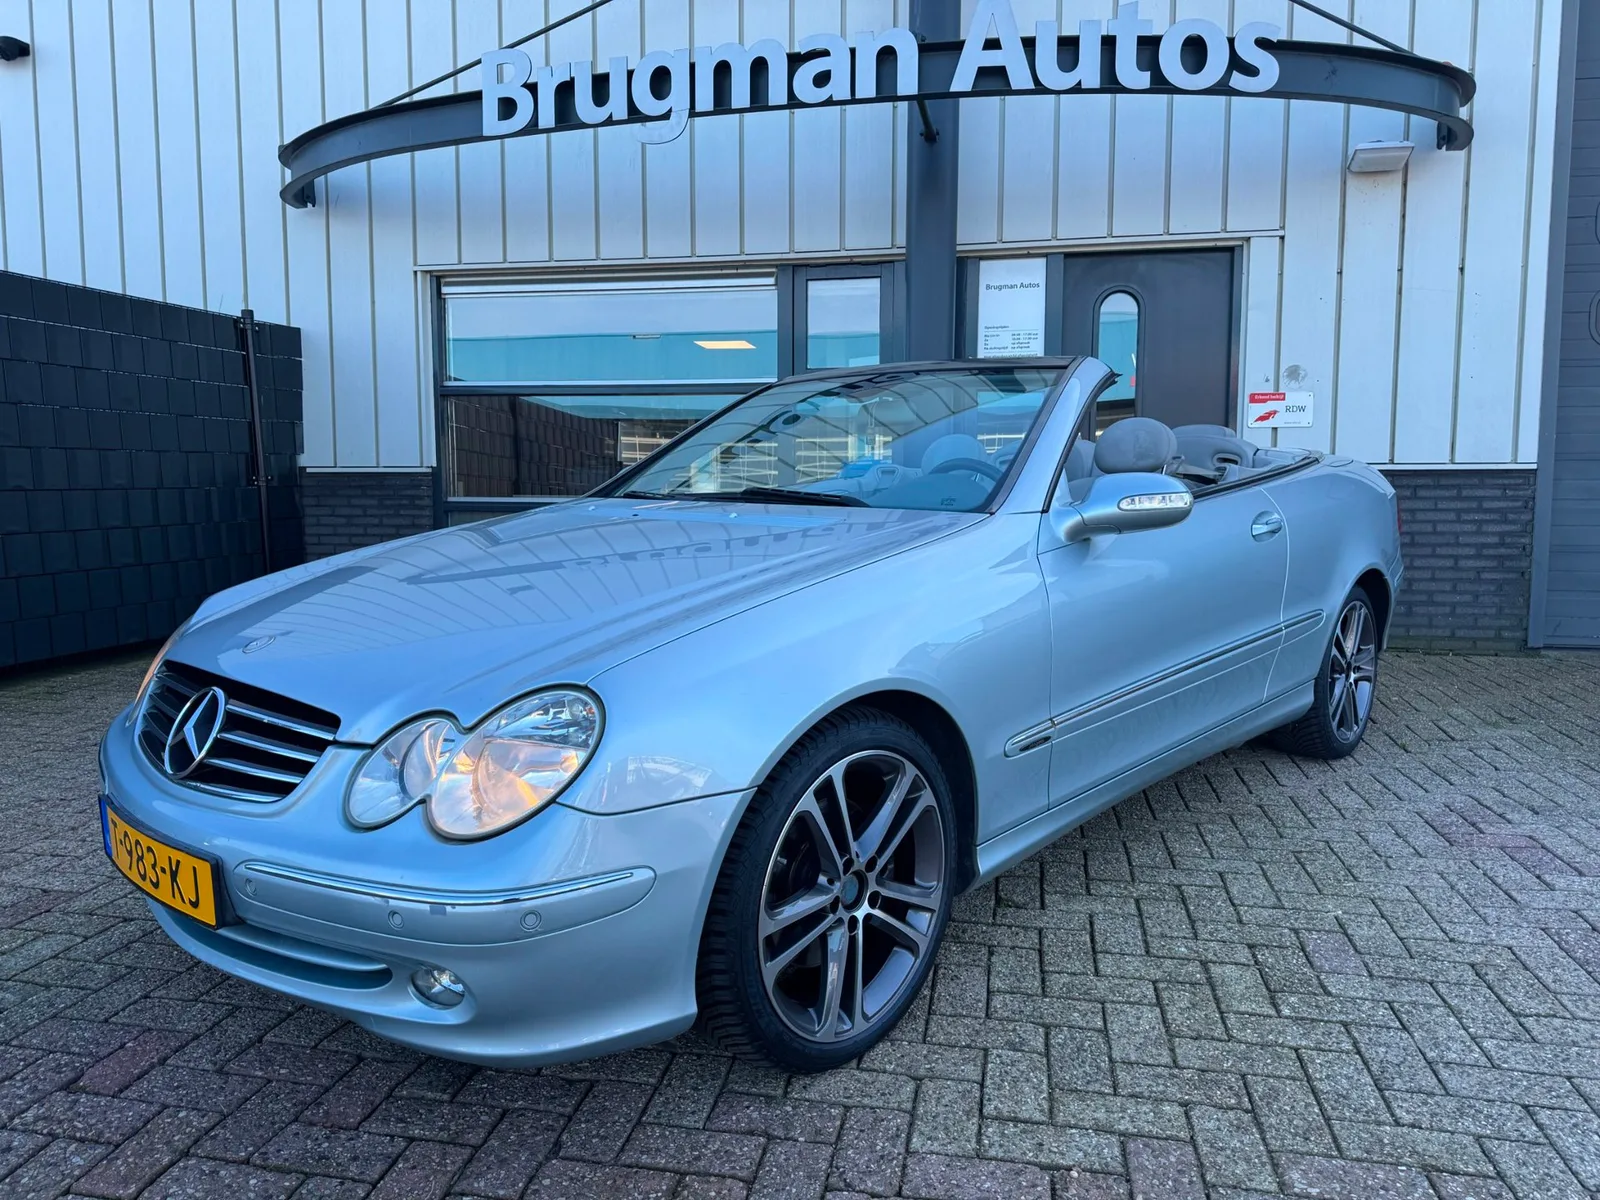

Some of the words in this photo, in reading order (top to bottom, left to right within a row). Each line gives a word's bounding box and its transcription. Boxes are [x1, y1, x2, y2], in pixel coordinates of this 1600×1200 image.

[480, 27, 919, 145] Brugman
[949, 0, 1282, 93] Autos
[985, 283, 1018, 291] Brugman
[1285, 405, 1307, 413] RDW
[110, 816, 201, 909] T-983-KJ
